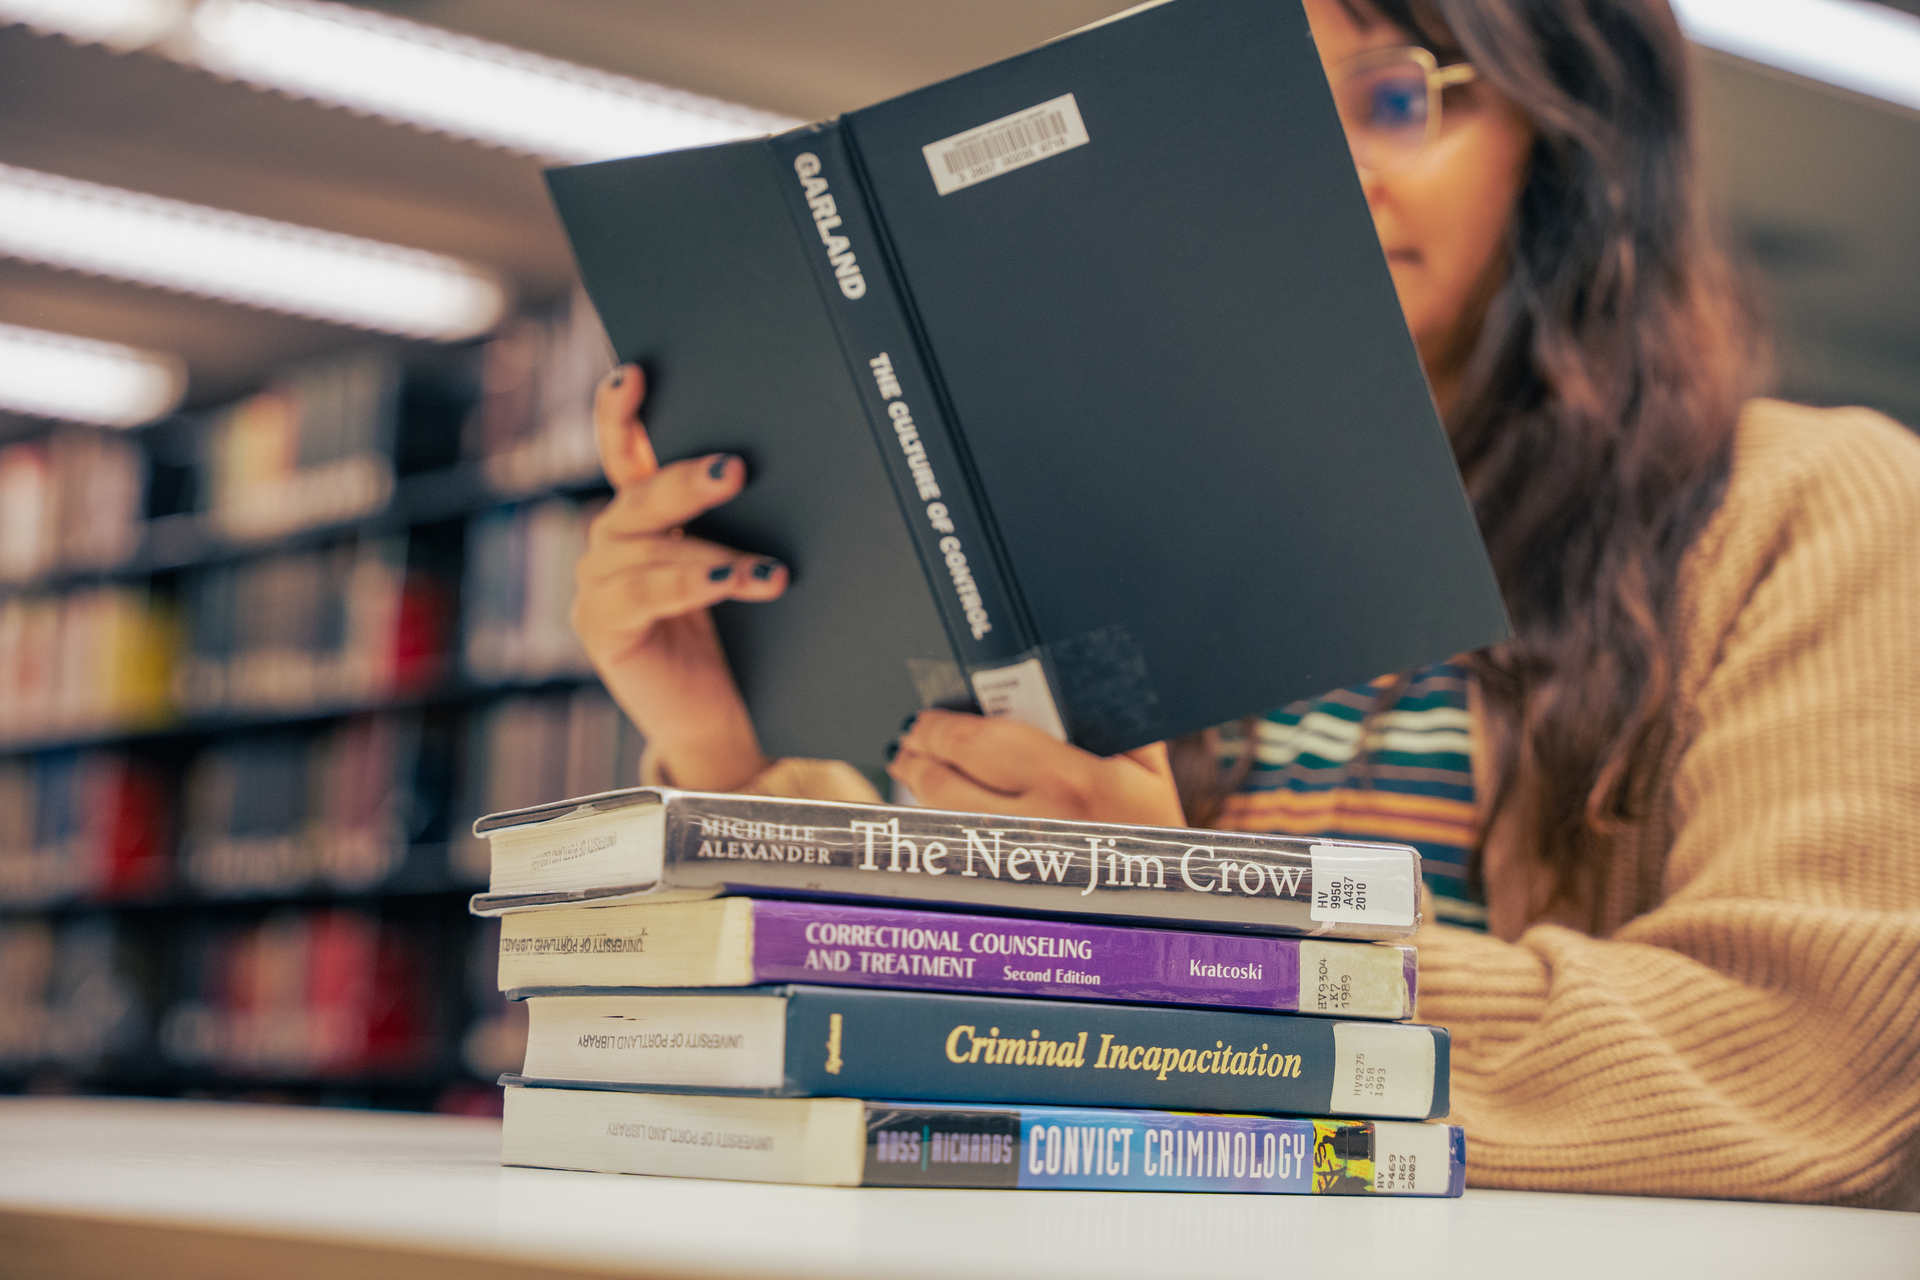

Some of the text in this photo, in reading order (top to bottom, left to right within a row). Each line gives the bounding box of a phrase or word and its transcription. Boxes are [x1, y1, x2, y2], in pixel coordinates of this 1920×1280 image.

[794, 152, 867, 300] GARLAND
[869, 352, 992, 641] THE CULTURE OF CONTROL
[700, 819, 816, 842] MICHELLE
[698, 840, 831, 865] ALEXANDER
[851, 817, 1306, 897] The New Jim Crow
[1318, 891, 1328, 908] HV
[1331, 882, 1341, 909] 9950
[1344, 877, 1354, 909] .A437
[1356, 883, 1366, 911] 2010
[534, 937, 578, 952] PORTLAND
[579, 937, 591, 951] OF
[593, 937, 643, 952] UNIVERSITY
[805, 922, 1093, 960] CORRECTIONAL COUNSELING
[804, 949, 977, 978] AND TREATMENT
[1003, 965, 1100, 985] Second Edition
[1190, 959, 1263, 980] Kratcoski
[1318, 958, 1328, 1010] HV9304
[1342, 974, 1352, 1008] 1989
[577, 1033, 744, 1049] UNIVERSITY OF PORTLAND LIBRARY
[946, 1025, 1301, 1080] Criminal Incapacitation
[1353, 1053, 1364, 1096] HV9275
[1365, 1068, 1375, 1095] .S58
[1375, 1068, 1386, 1096] 1993
[606, 1121, 773, 1150] UNIVERSITY OF PORTLAND LIBRARY
[876, 1130, 1013, 1164] ROSS RICHARDS
[1028, 1124, 1133, 1176] CONVICT
[1144, 1128, 1306, 1179] CRIMINOLOGY
[1377, 1172, 1385, 1189] HV
[1388, 1154, 1396, 1189] 9469
[1399, 1155, 1407, 1189] .R67
[1408, 1155, 1416, 1189] 2003
